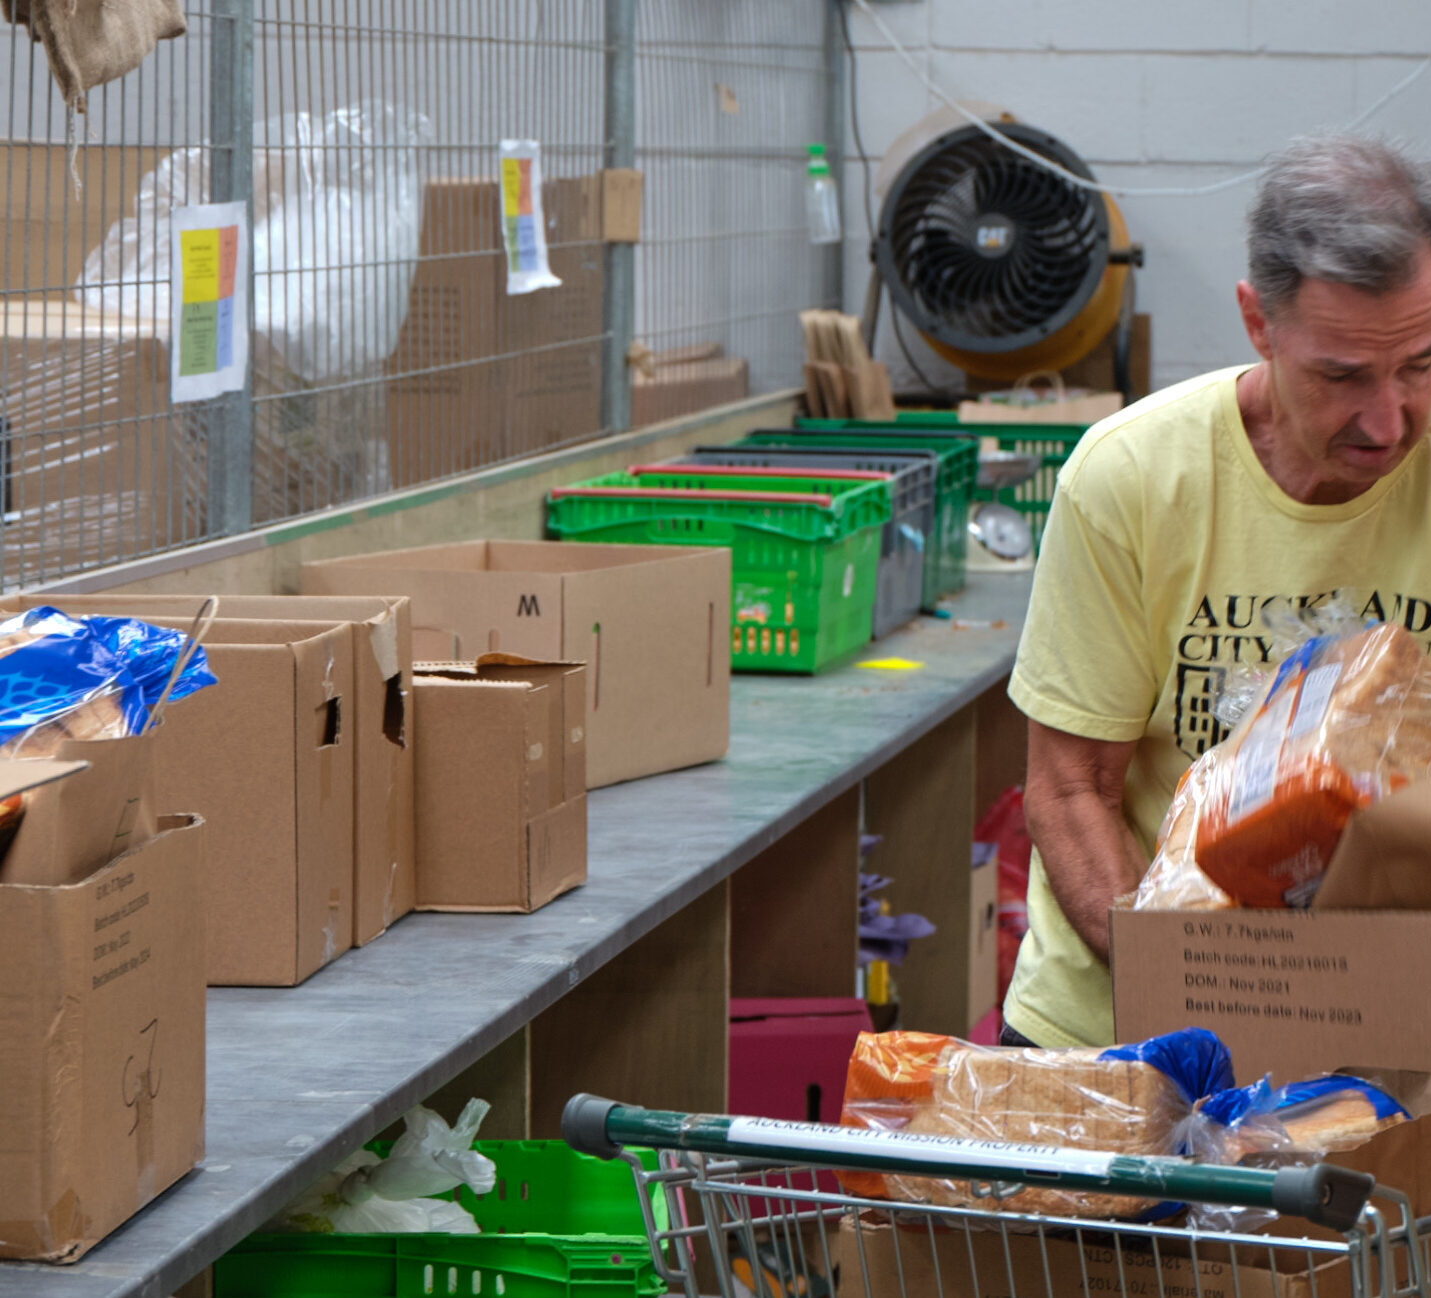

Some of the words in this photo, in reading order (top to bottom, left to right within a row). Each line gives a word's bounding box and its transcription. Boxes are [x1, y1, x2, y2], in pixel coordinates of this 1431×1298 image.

[977, 226, 1006, 247] CAT
[1177, 634, 1274, 663] CITY
[1184, 948, 1220, 964] Batch
[1229, 976, 1255, 992] Nov
[1186, 997, 1215, 1014] Best
[1218, 999, 1260, 1016] before
[1300, 1005, 1325, 1022] Nov
